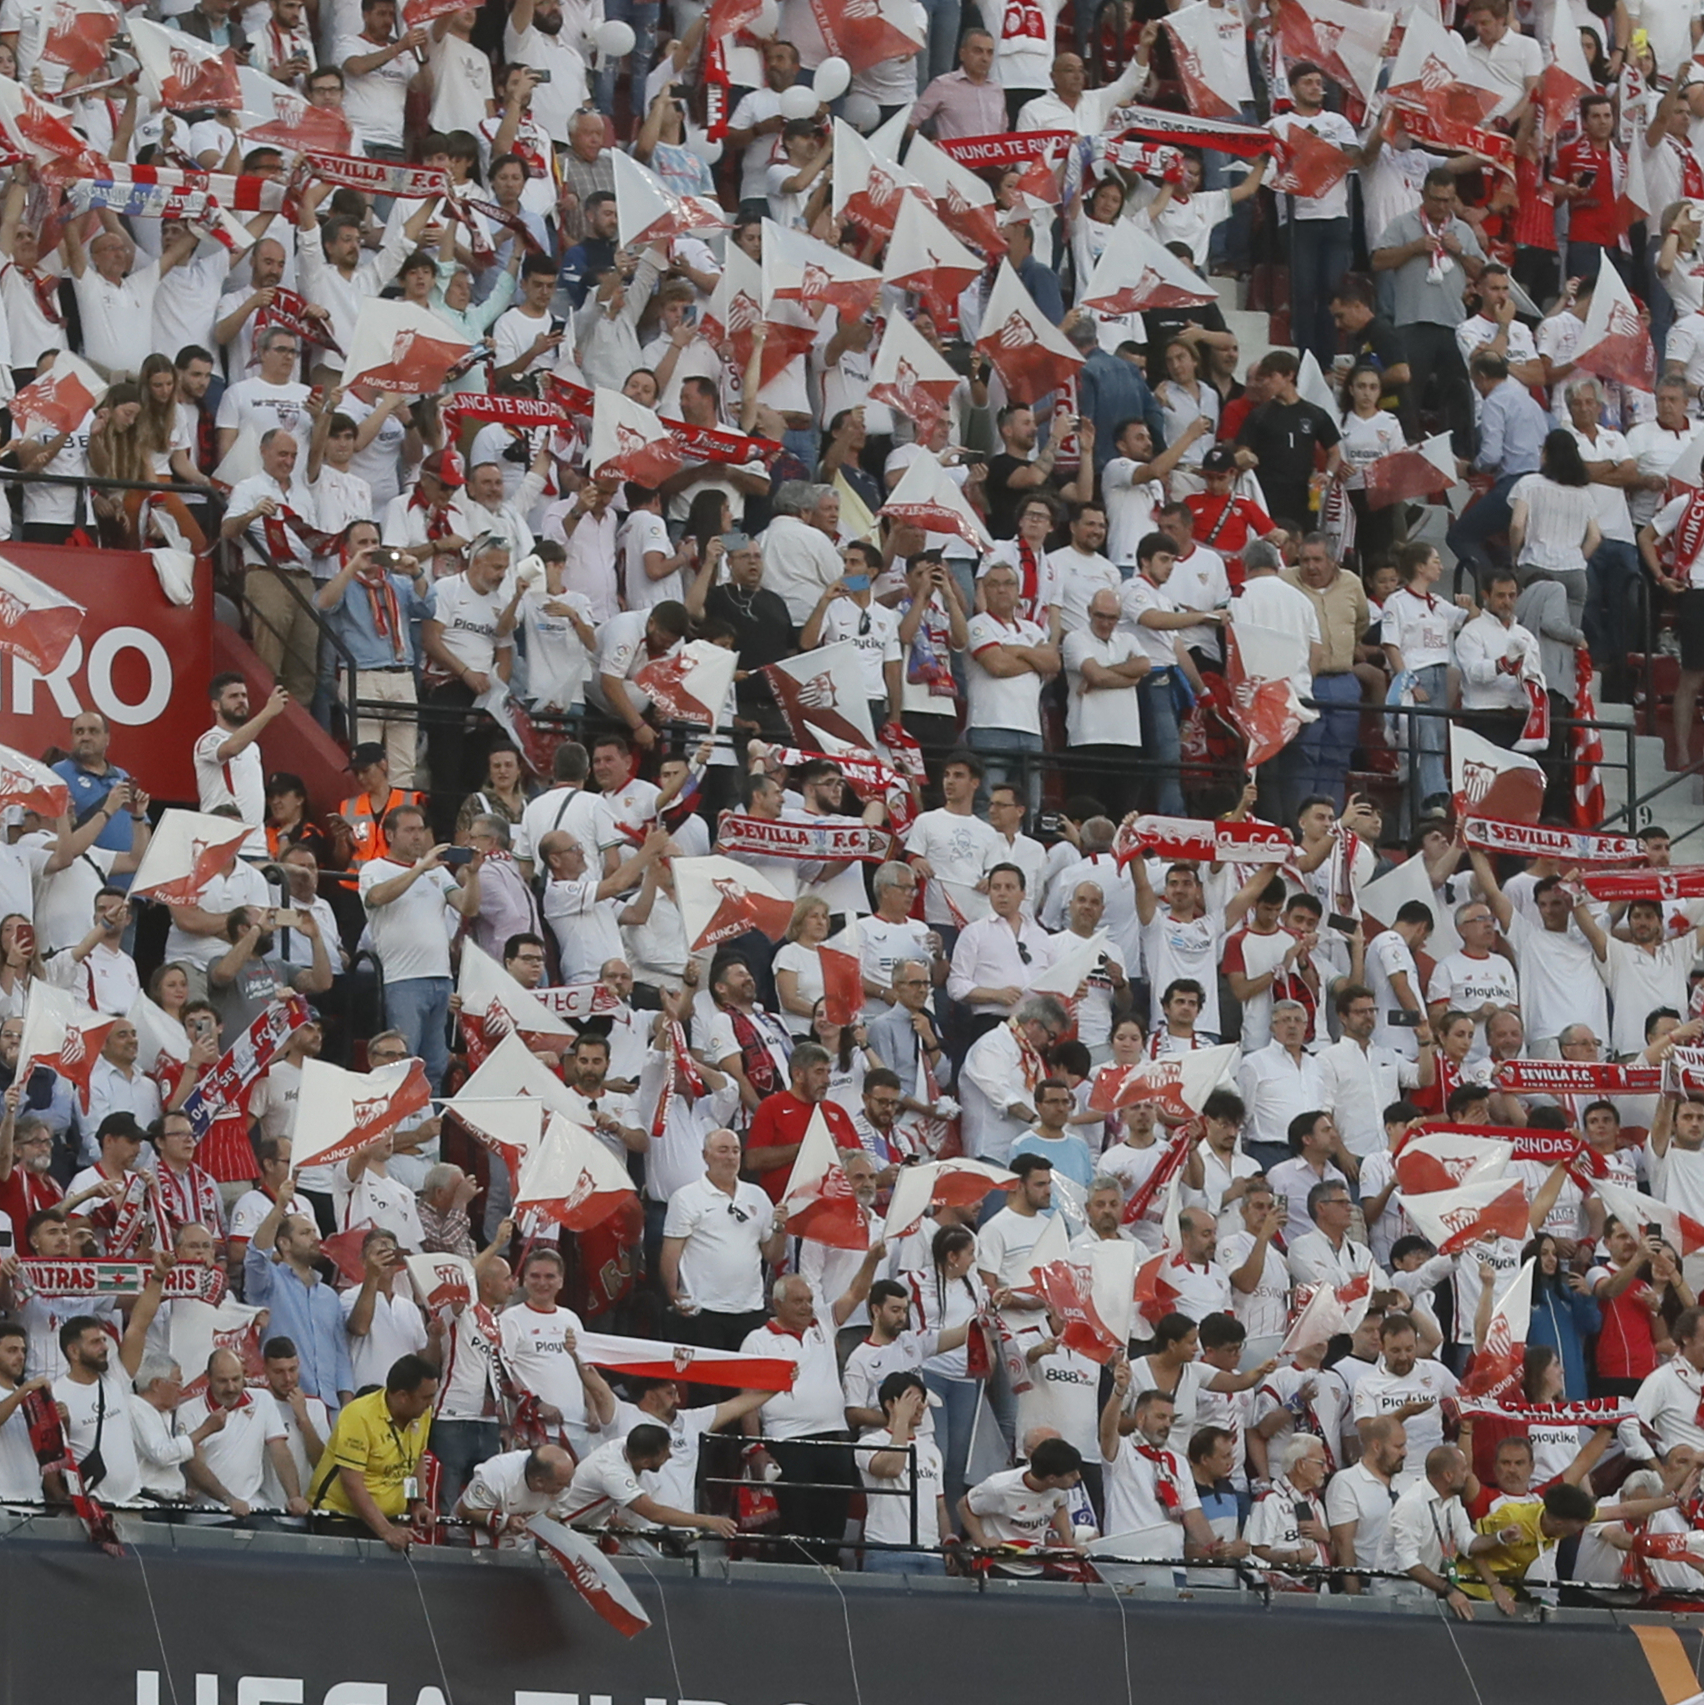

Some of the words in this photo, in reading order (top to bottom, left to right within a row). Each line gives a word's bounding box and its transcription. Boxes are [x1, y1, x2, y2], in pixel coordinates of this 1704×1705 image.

[951, 141, 1005, 160] NUNCA
[1006, 140, 1027, 155] TE
[496, 398, 514, 413] TE
[734, 824, 810, 847] SEVILLA
[834, 830, 865, 847] F.C.
[1486, 822, 1572, 849] SEVILLA
[705, 925, 739, 943] NUNCA
[1519, 1068, 1570, 1082] SEVILLA
[1514, 1137, 1573, 1154] RINDAS
